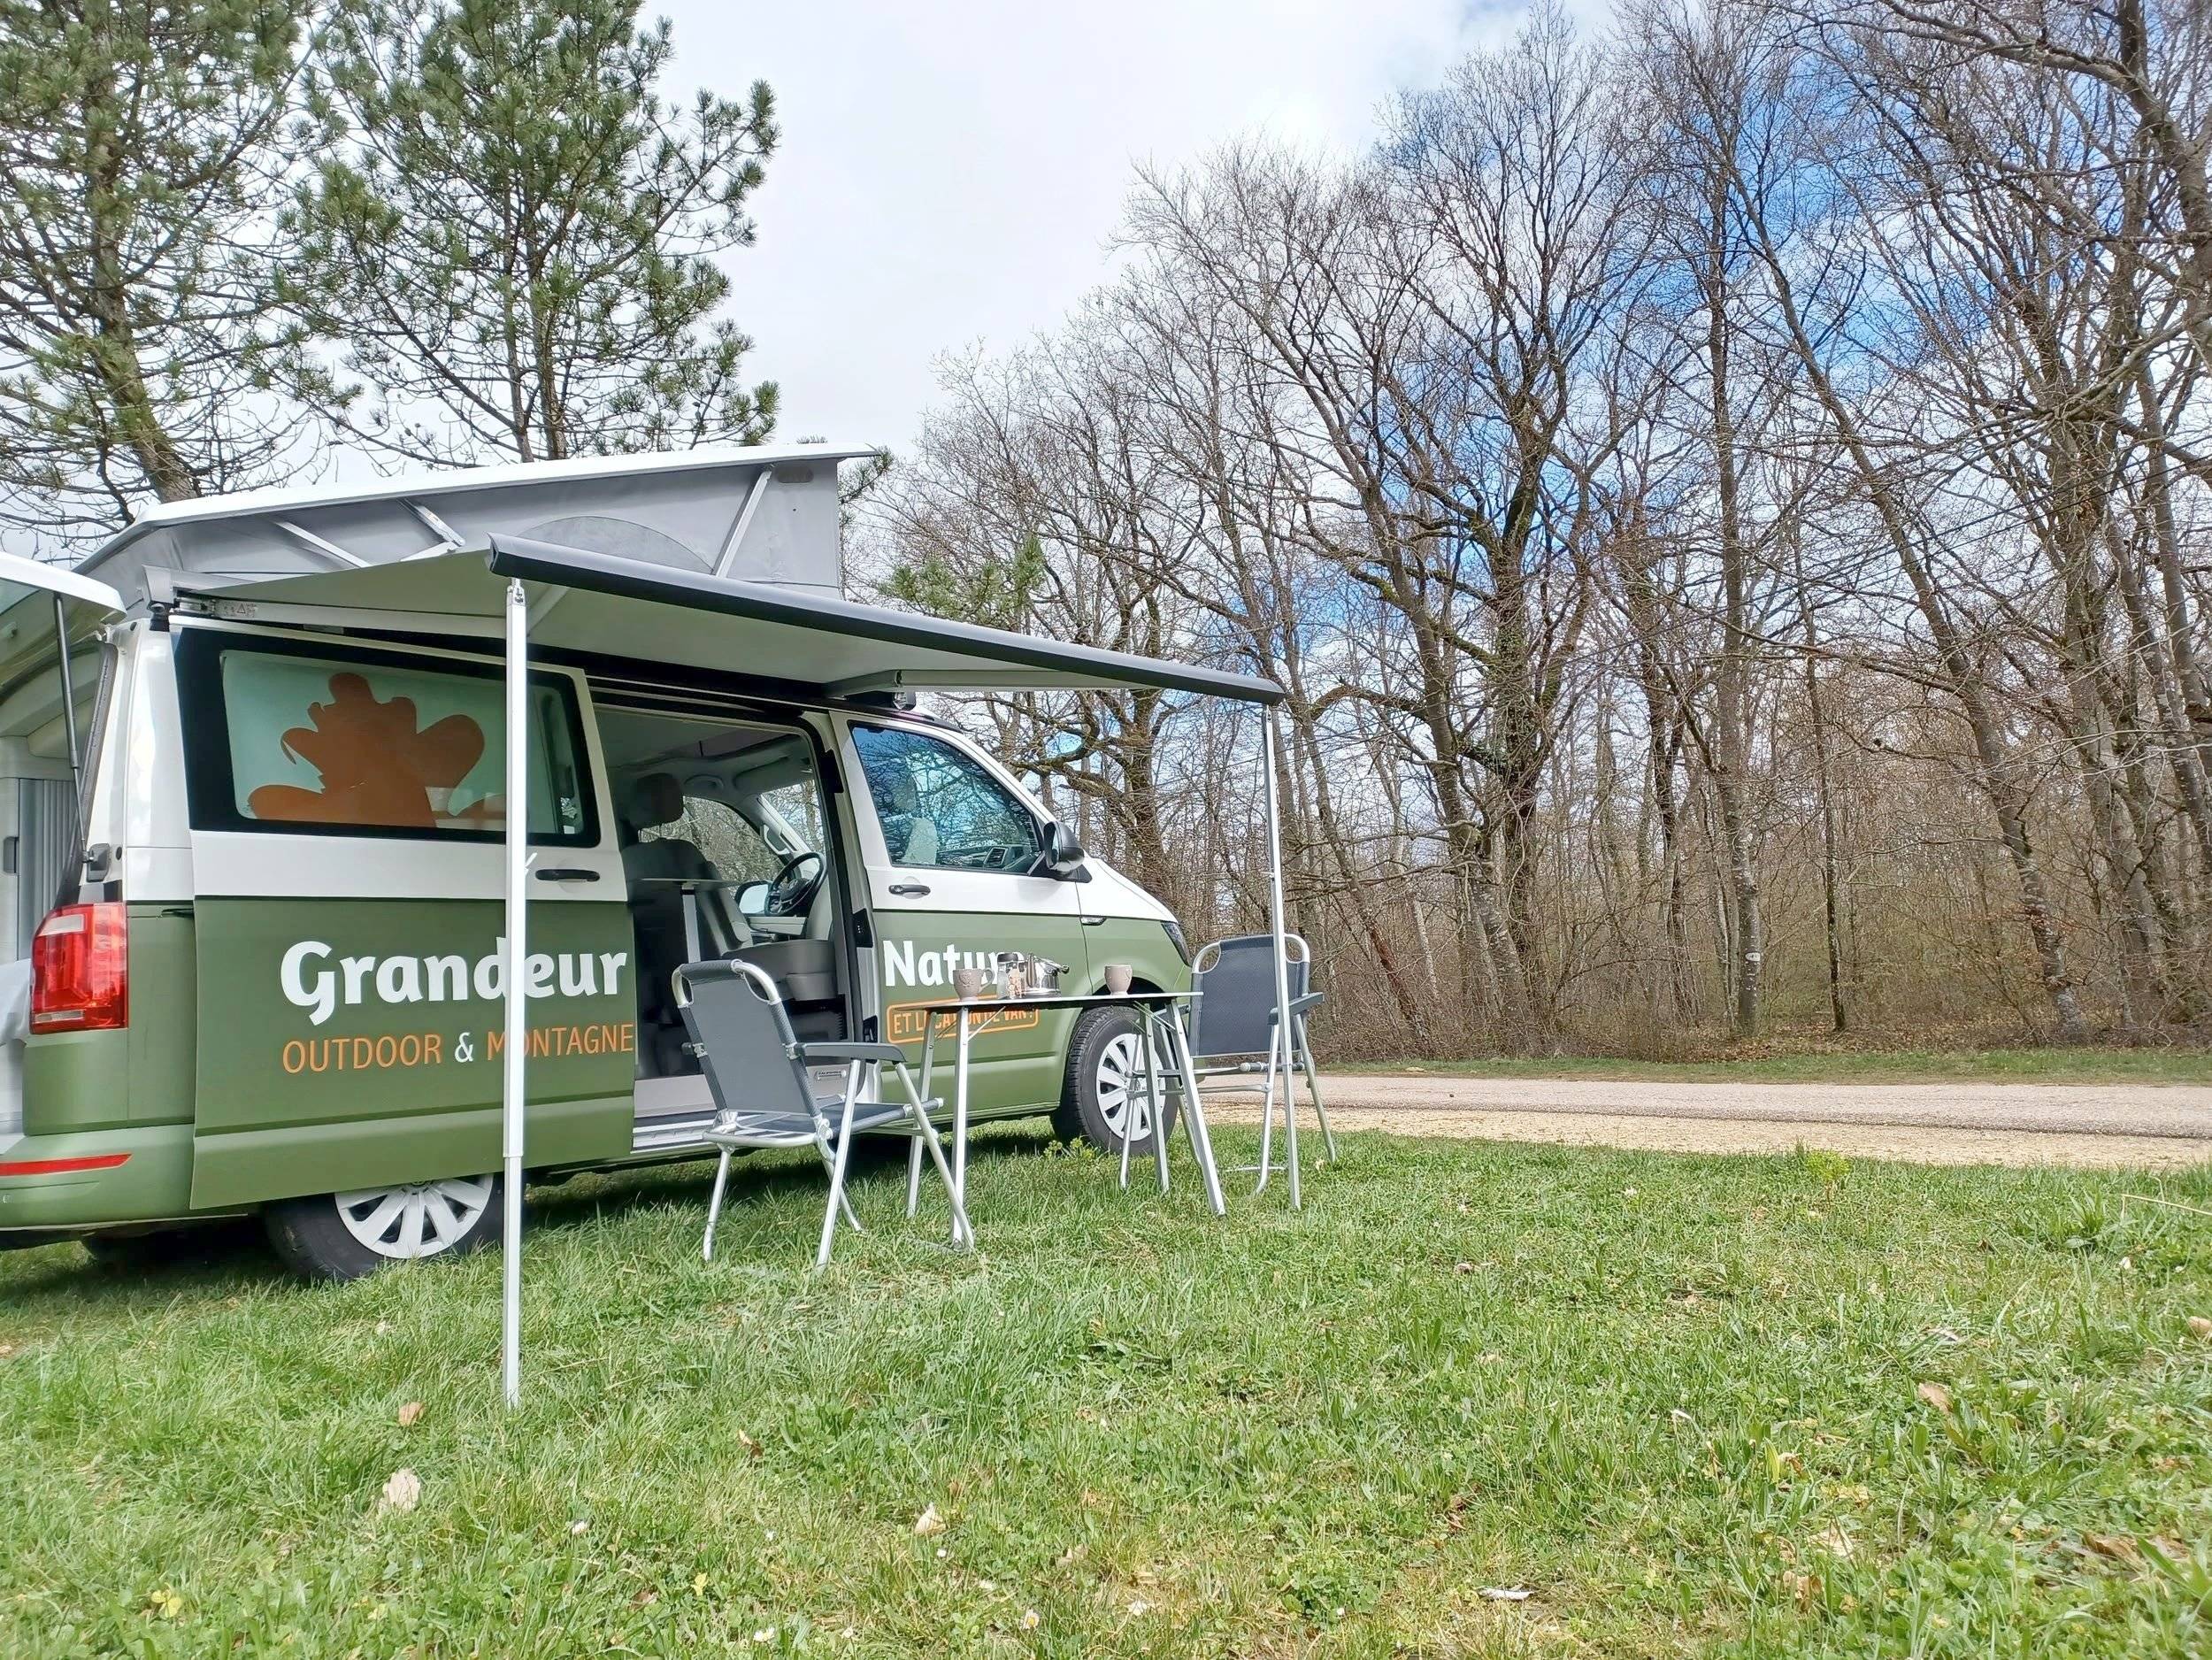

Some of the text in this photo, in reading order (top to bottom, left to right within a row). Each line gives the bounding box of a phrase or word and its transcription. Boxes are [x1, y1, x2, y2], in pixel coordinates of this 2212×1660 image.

[280, 936, 627, 1026] Grandeur
[883, 940, 1025, 987] Natur
[893, 1012, 912, 1034] ET
[282, 1023, 634, 1073] OUTDOOR & MNTAGNE
